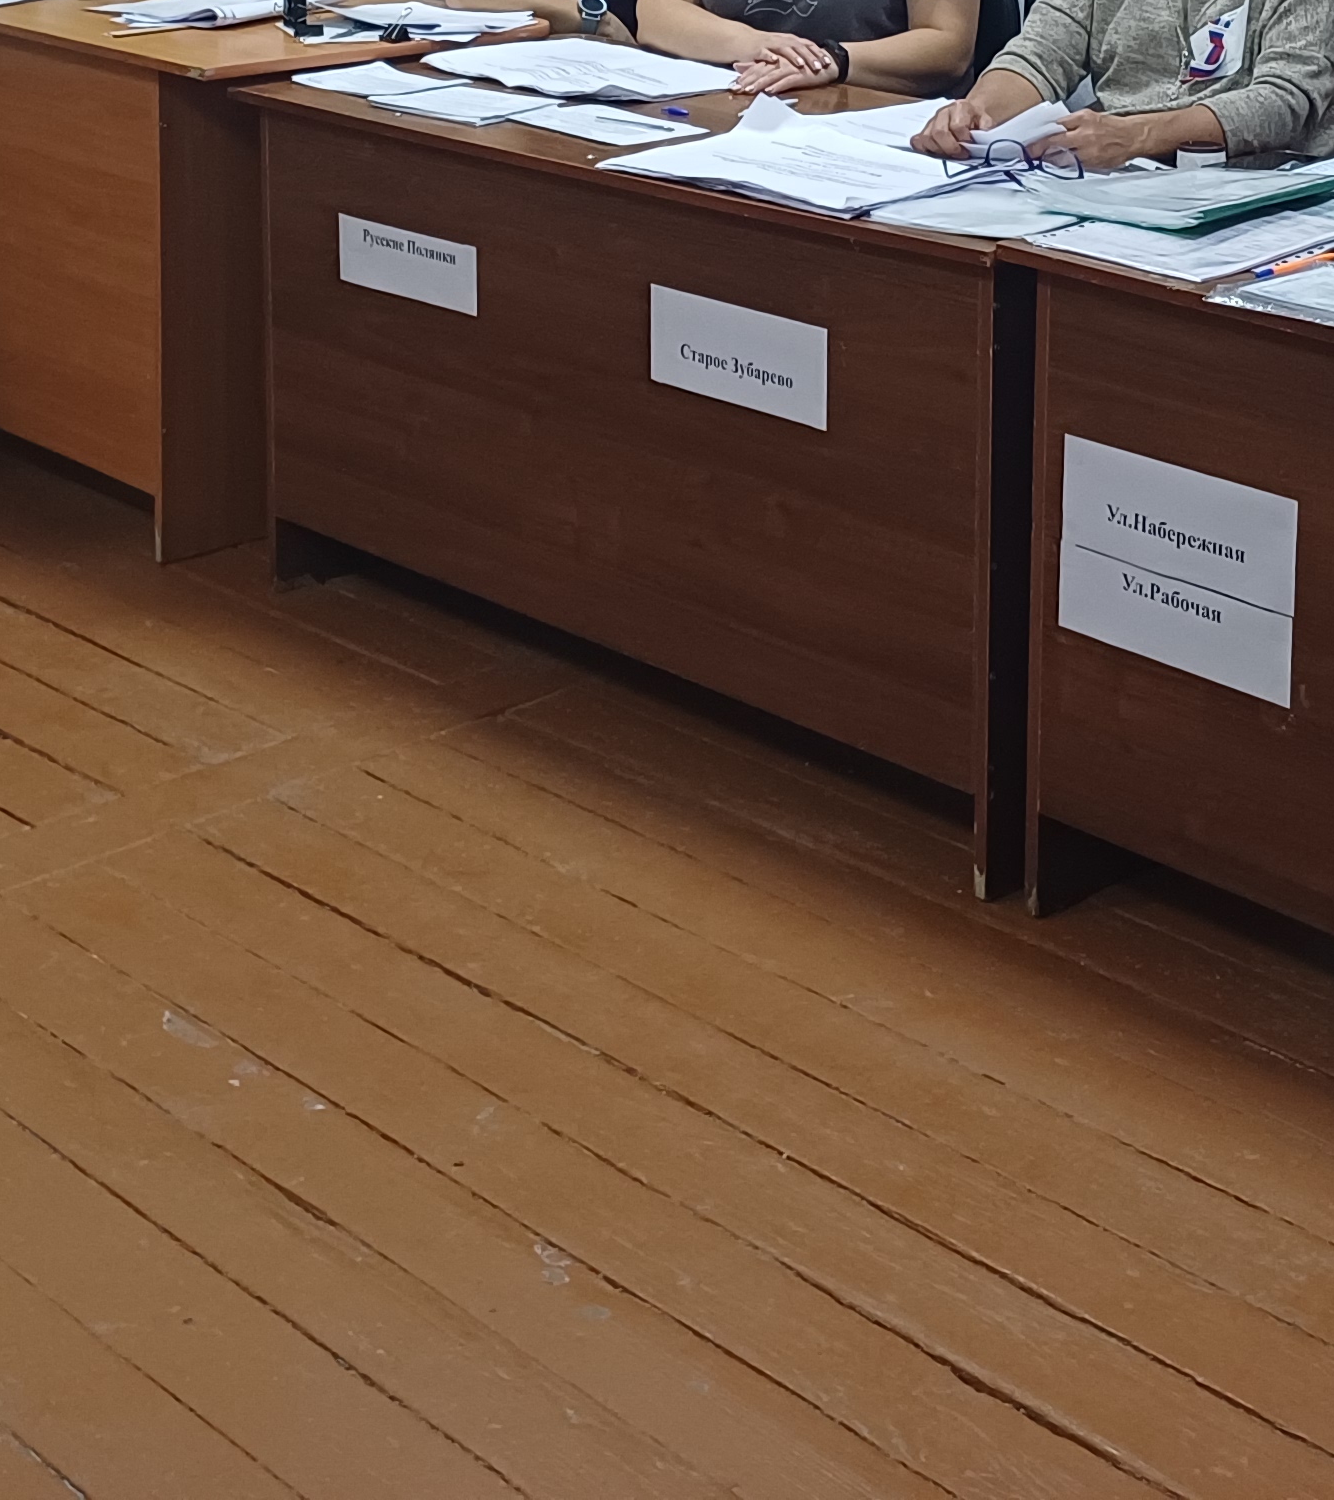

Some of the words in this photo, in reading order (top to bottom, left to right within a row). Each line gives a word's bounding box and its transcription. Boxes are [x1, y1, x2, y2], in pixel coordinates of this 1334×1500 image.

[363, 228, 405, 253] Русские
[407, 239, 457, 266] Полянки
[680, 343, 728, 371] Старое
[730, 356, 794, 389] Зубарево
[1106, 503, 1246, 564] Ул.Набережная
[1121, 572, 1222, 624] Ул.Рабочая
